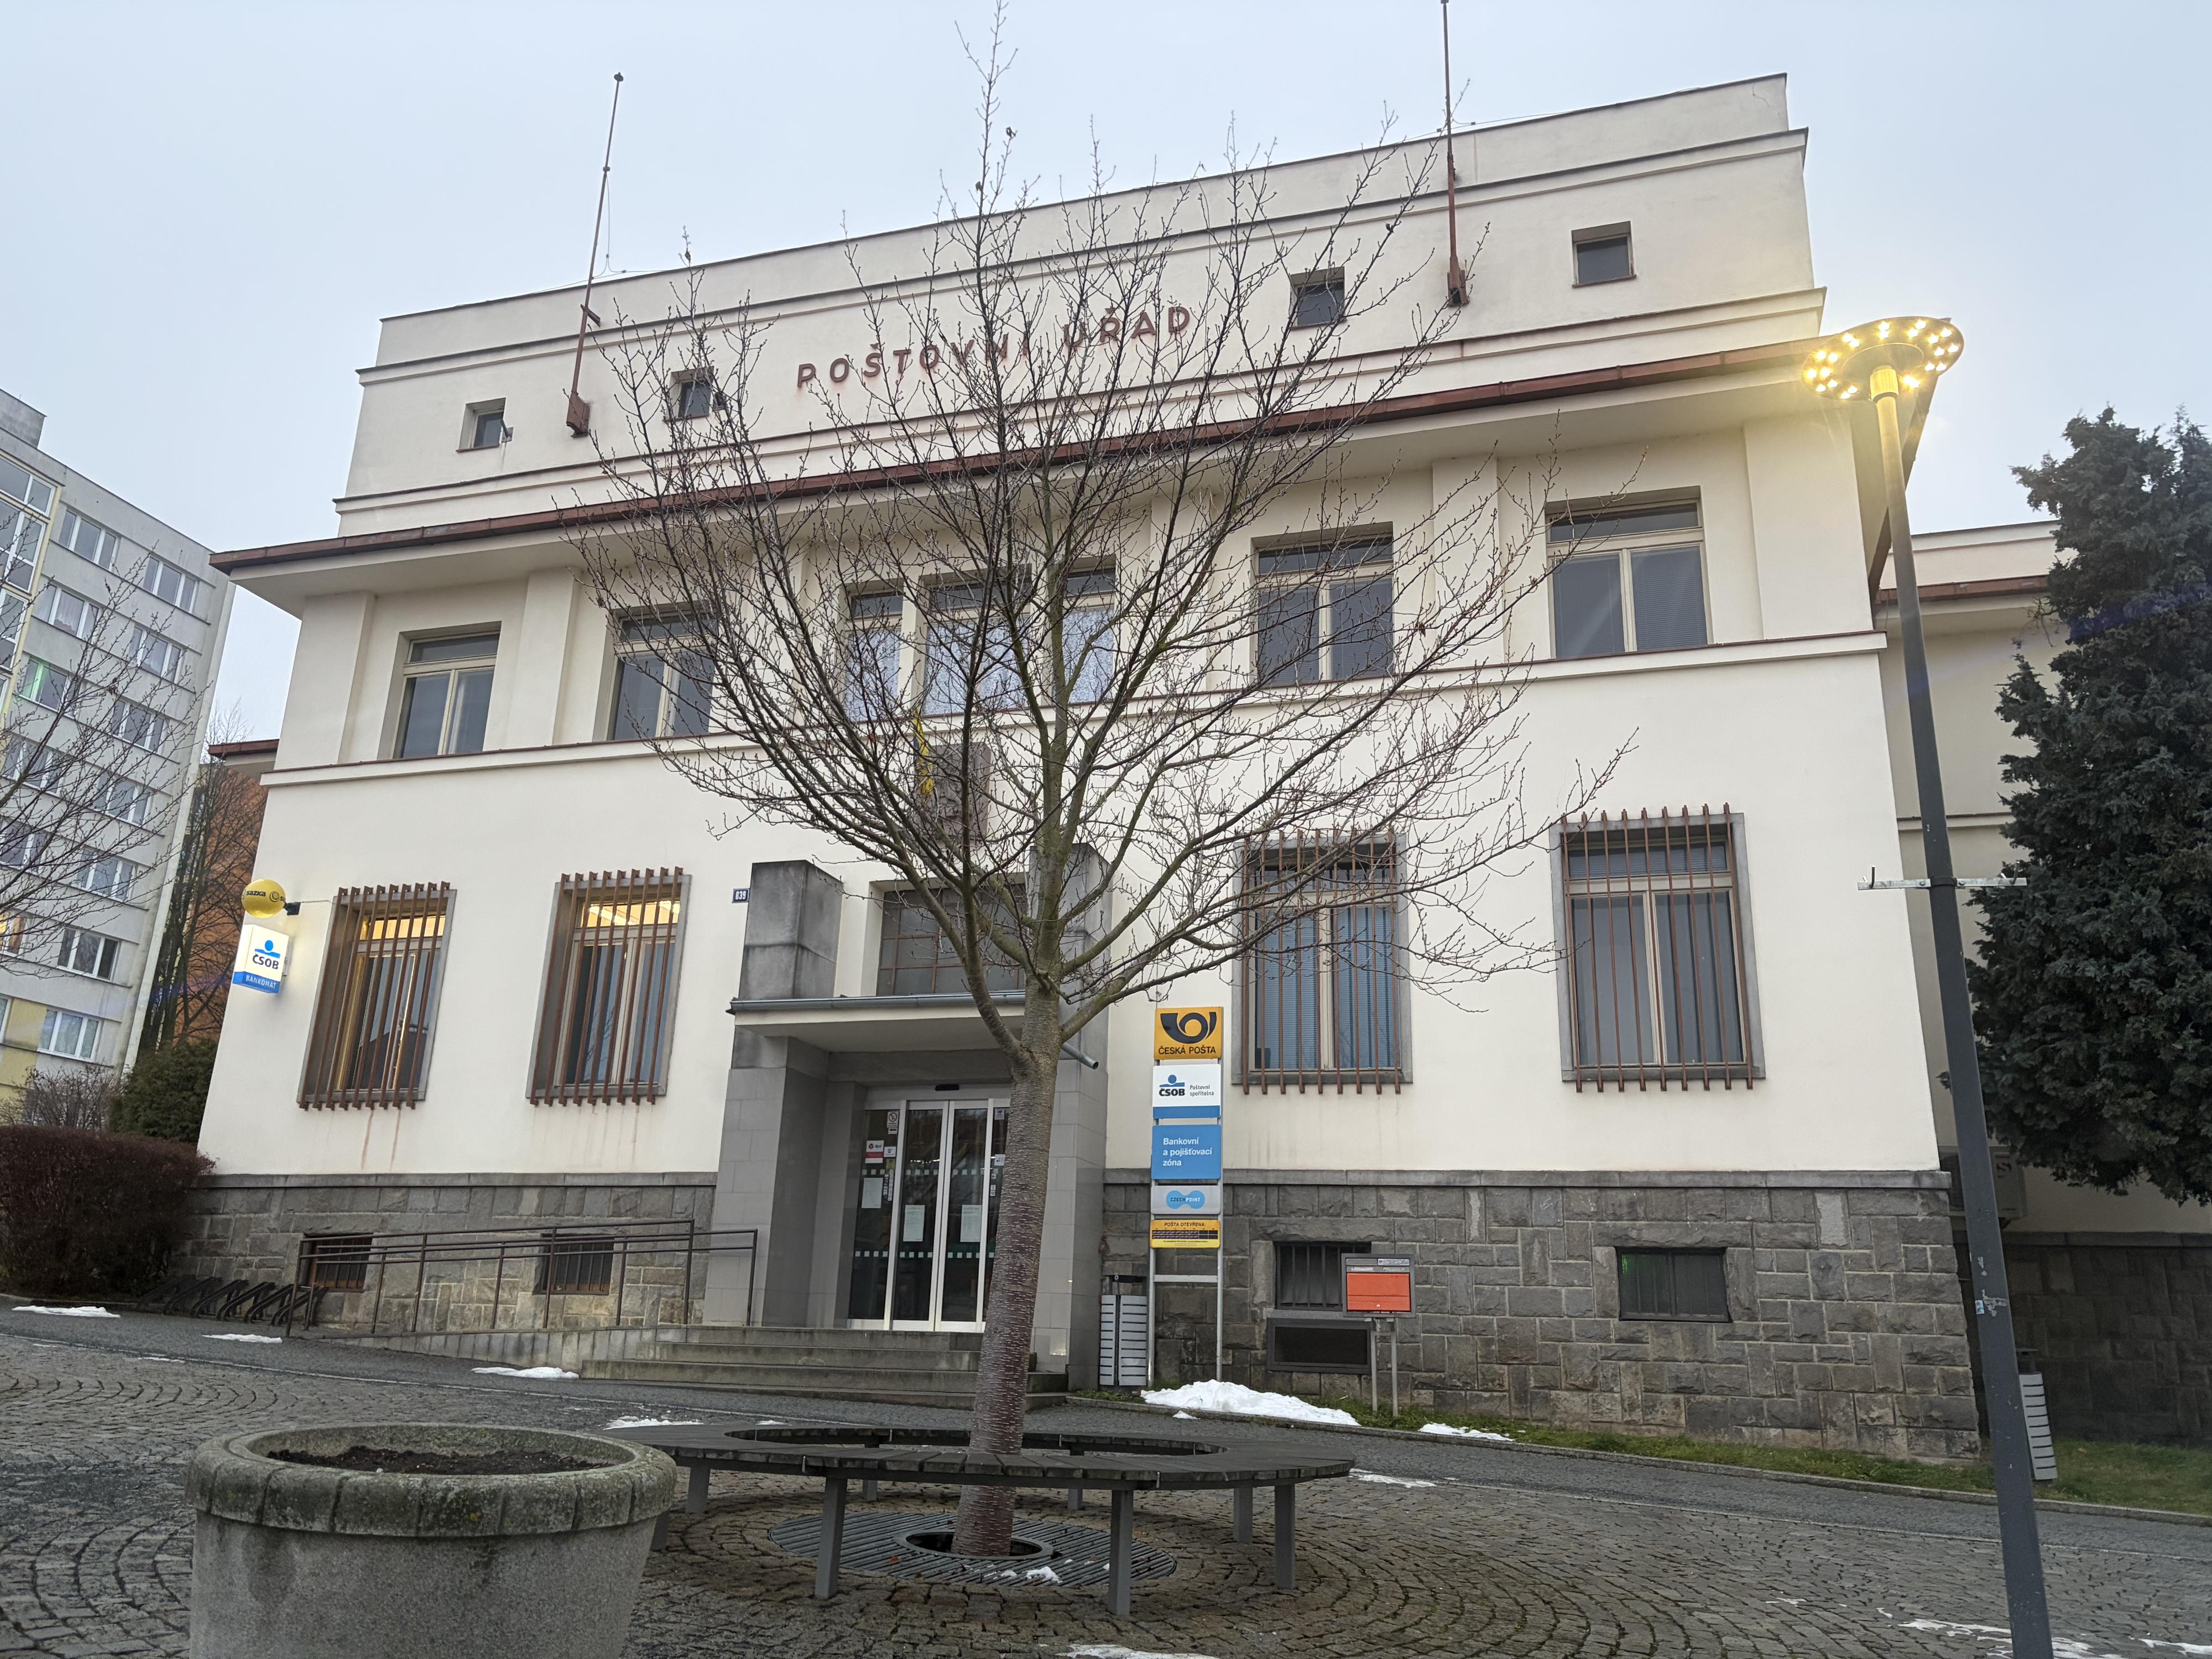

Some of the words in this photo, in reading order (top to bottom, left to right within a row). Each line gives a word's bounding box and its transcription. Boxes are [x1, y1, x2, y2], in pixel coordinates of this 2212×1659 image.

[735, 890, 747, 900] 839
[253, 953, 279, 970] ČSOB
[246, 975, 276, 989] BANKOMAT
[1158, 1045, 1186, 1055] ČESKÁ
[1189, 1045, 1216, 1054] POŠTA
[1159, 1088, 1185, 1097] ČSOB
[1163, 1137, 1199, 1145] Bankovní
[1170, 1147, 1213, 1157] pojišťovací
